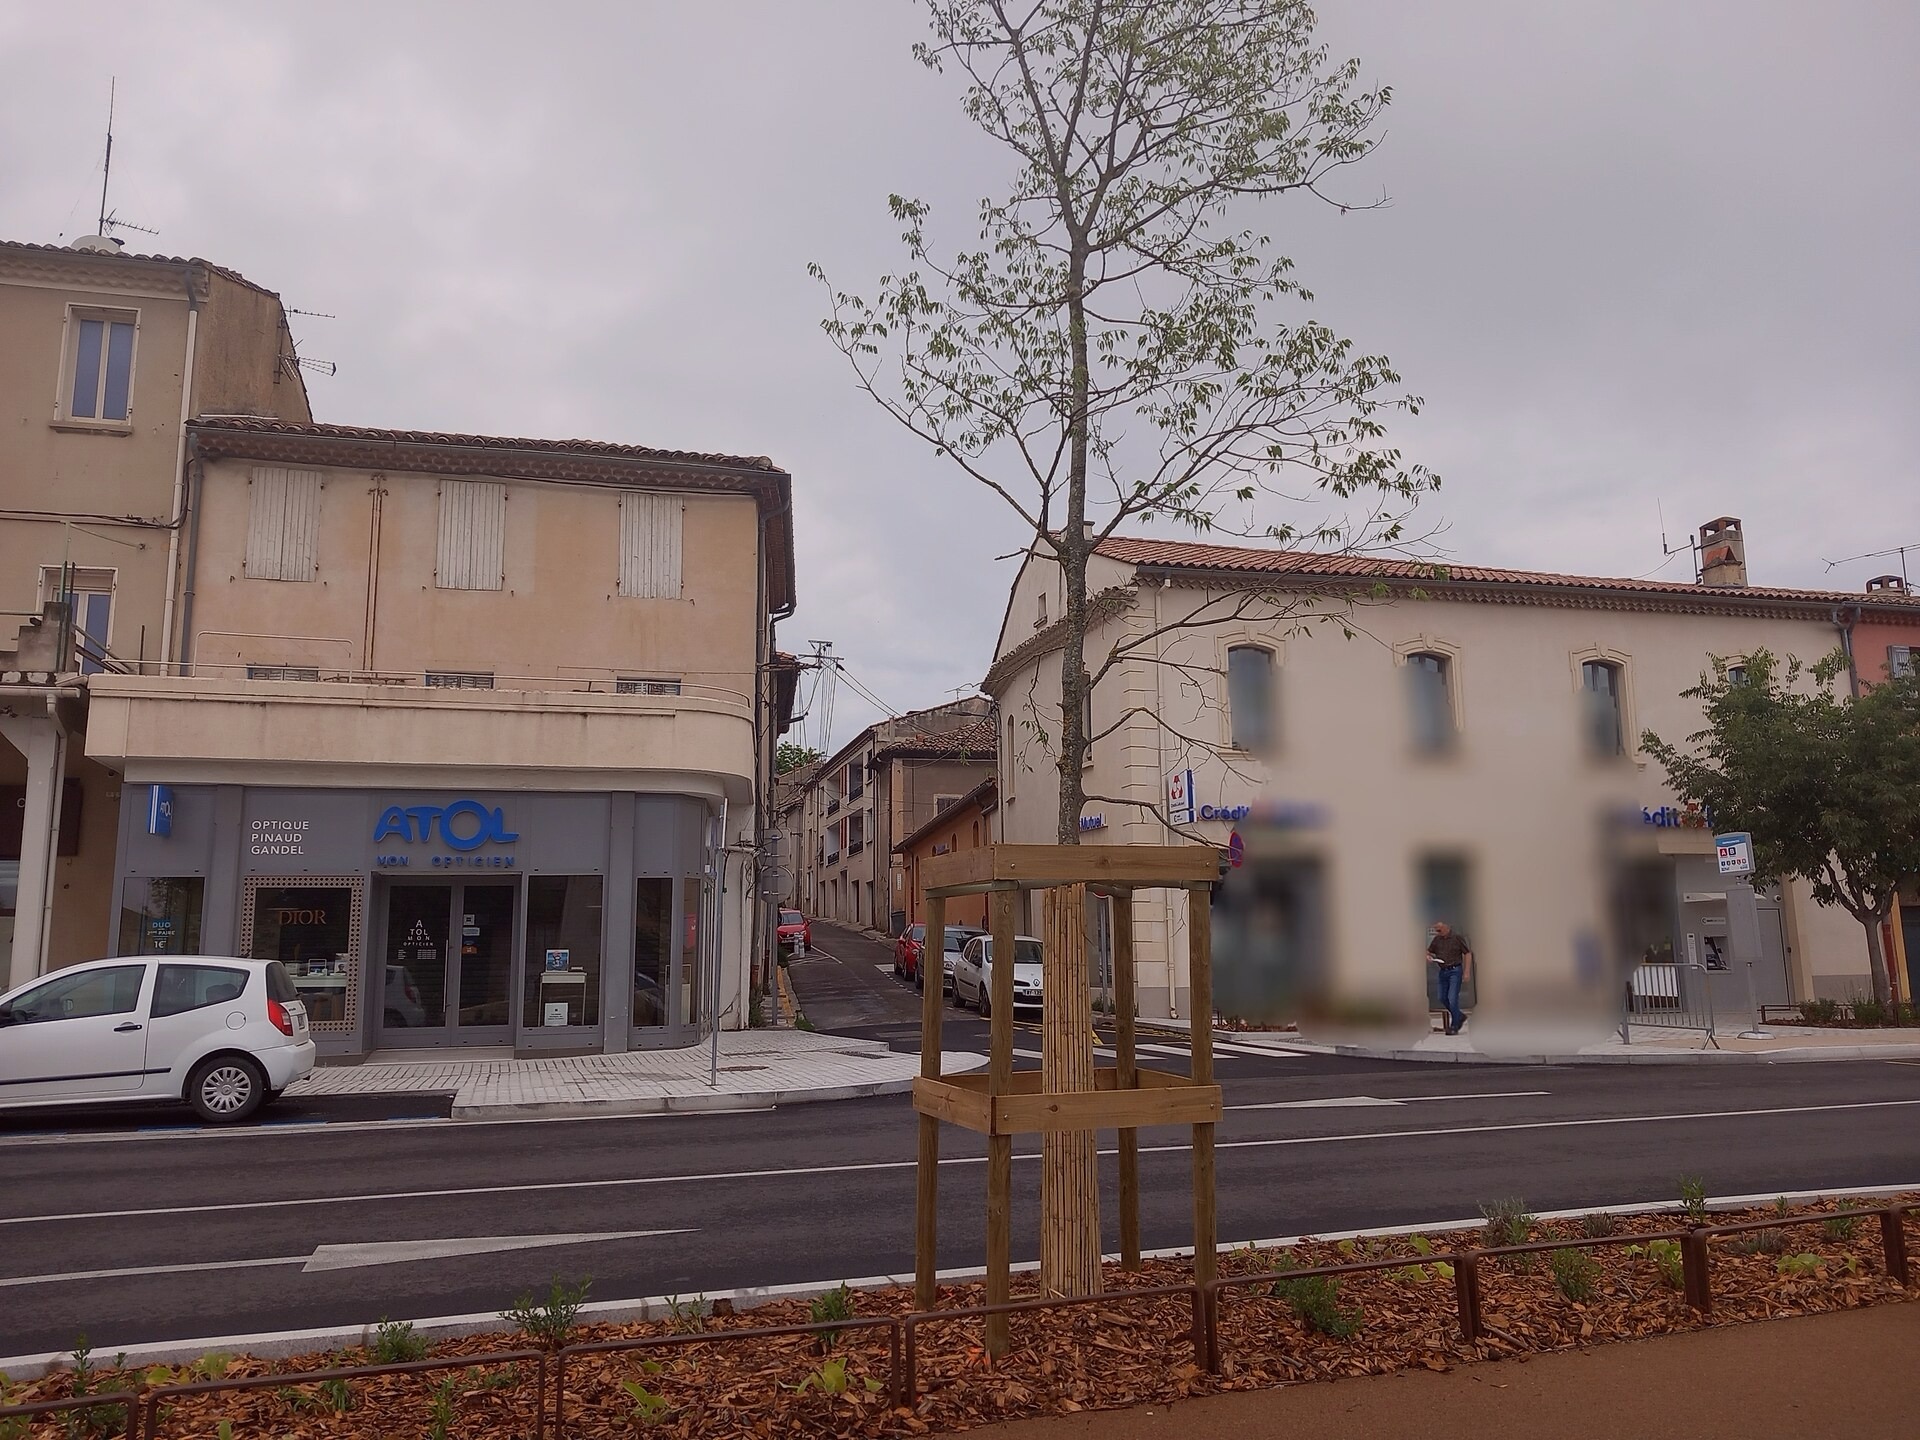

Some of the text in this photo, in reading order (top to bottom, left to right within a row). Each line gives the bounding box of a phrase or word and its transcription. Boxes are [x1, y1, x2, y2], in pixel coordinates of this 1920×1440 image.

[251, 820, 309, 831] OPTIQUE
[373, 799, 521, 852] ATOL
[251, 833, 302, 843] PINAUD
[251, 845, 304, 855] GANDEL
[377, 855, 516, 868] MON OPTICIEN
[277, 909, 327, 925] DIOR
[415, 919, 423, 928] A
[409, 928, 428, 936] TOL
